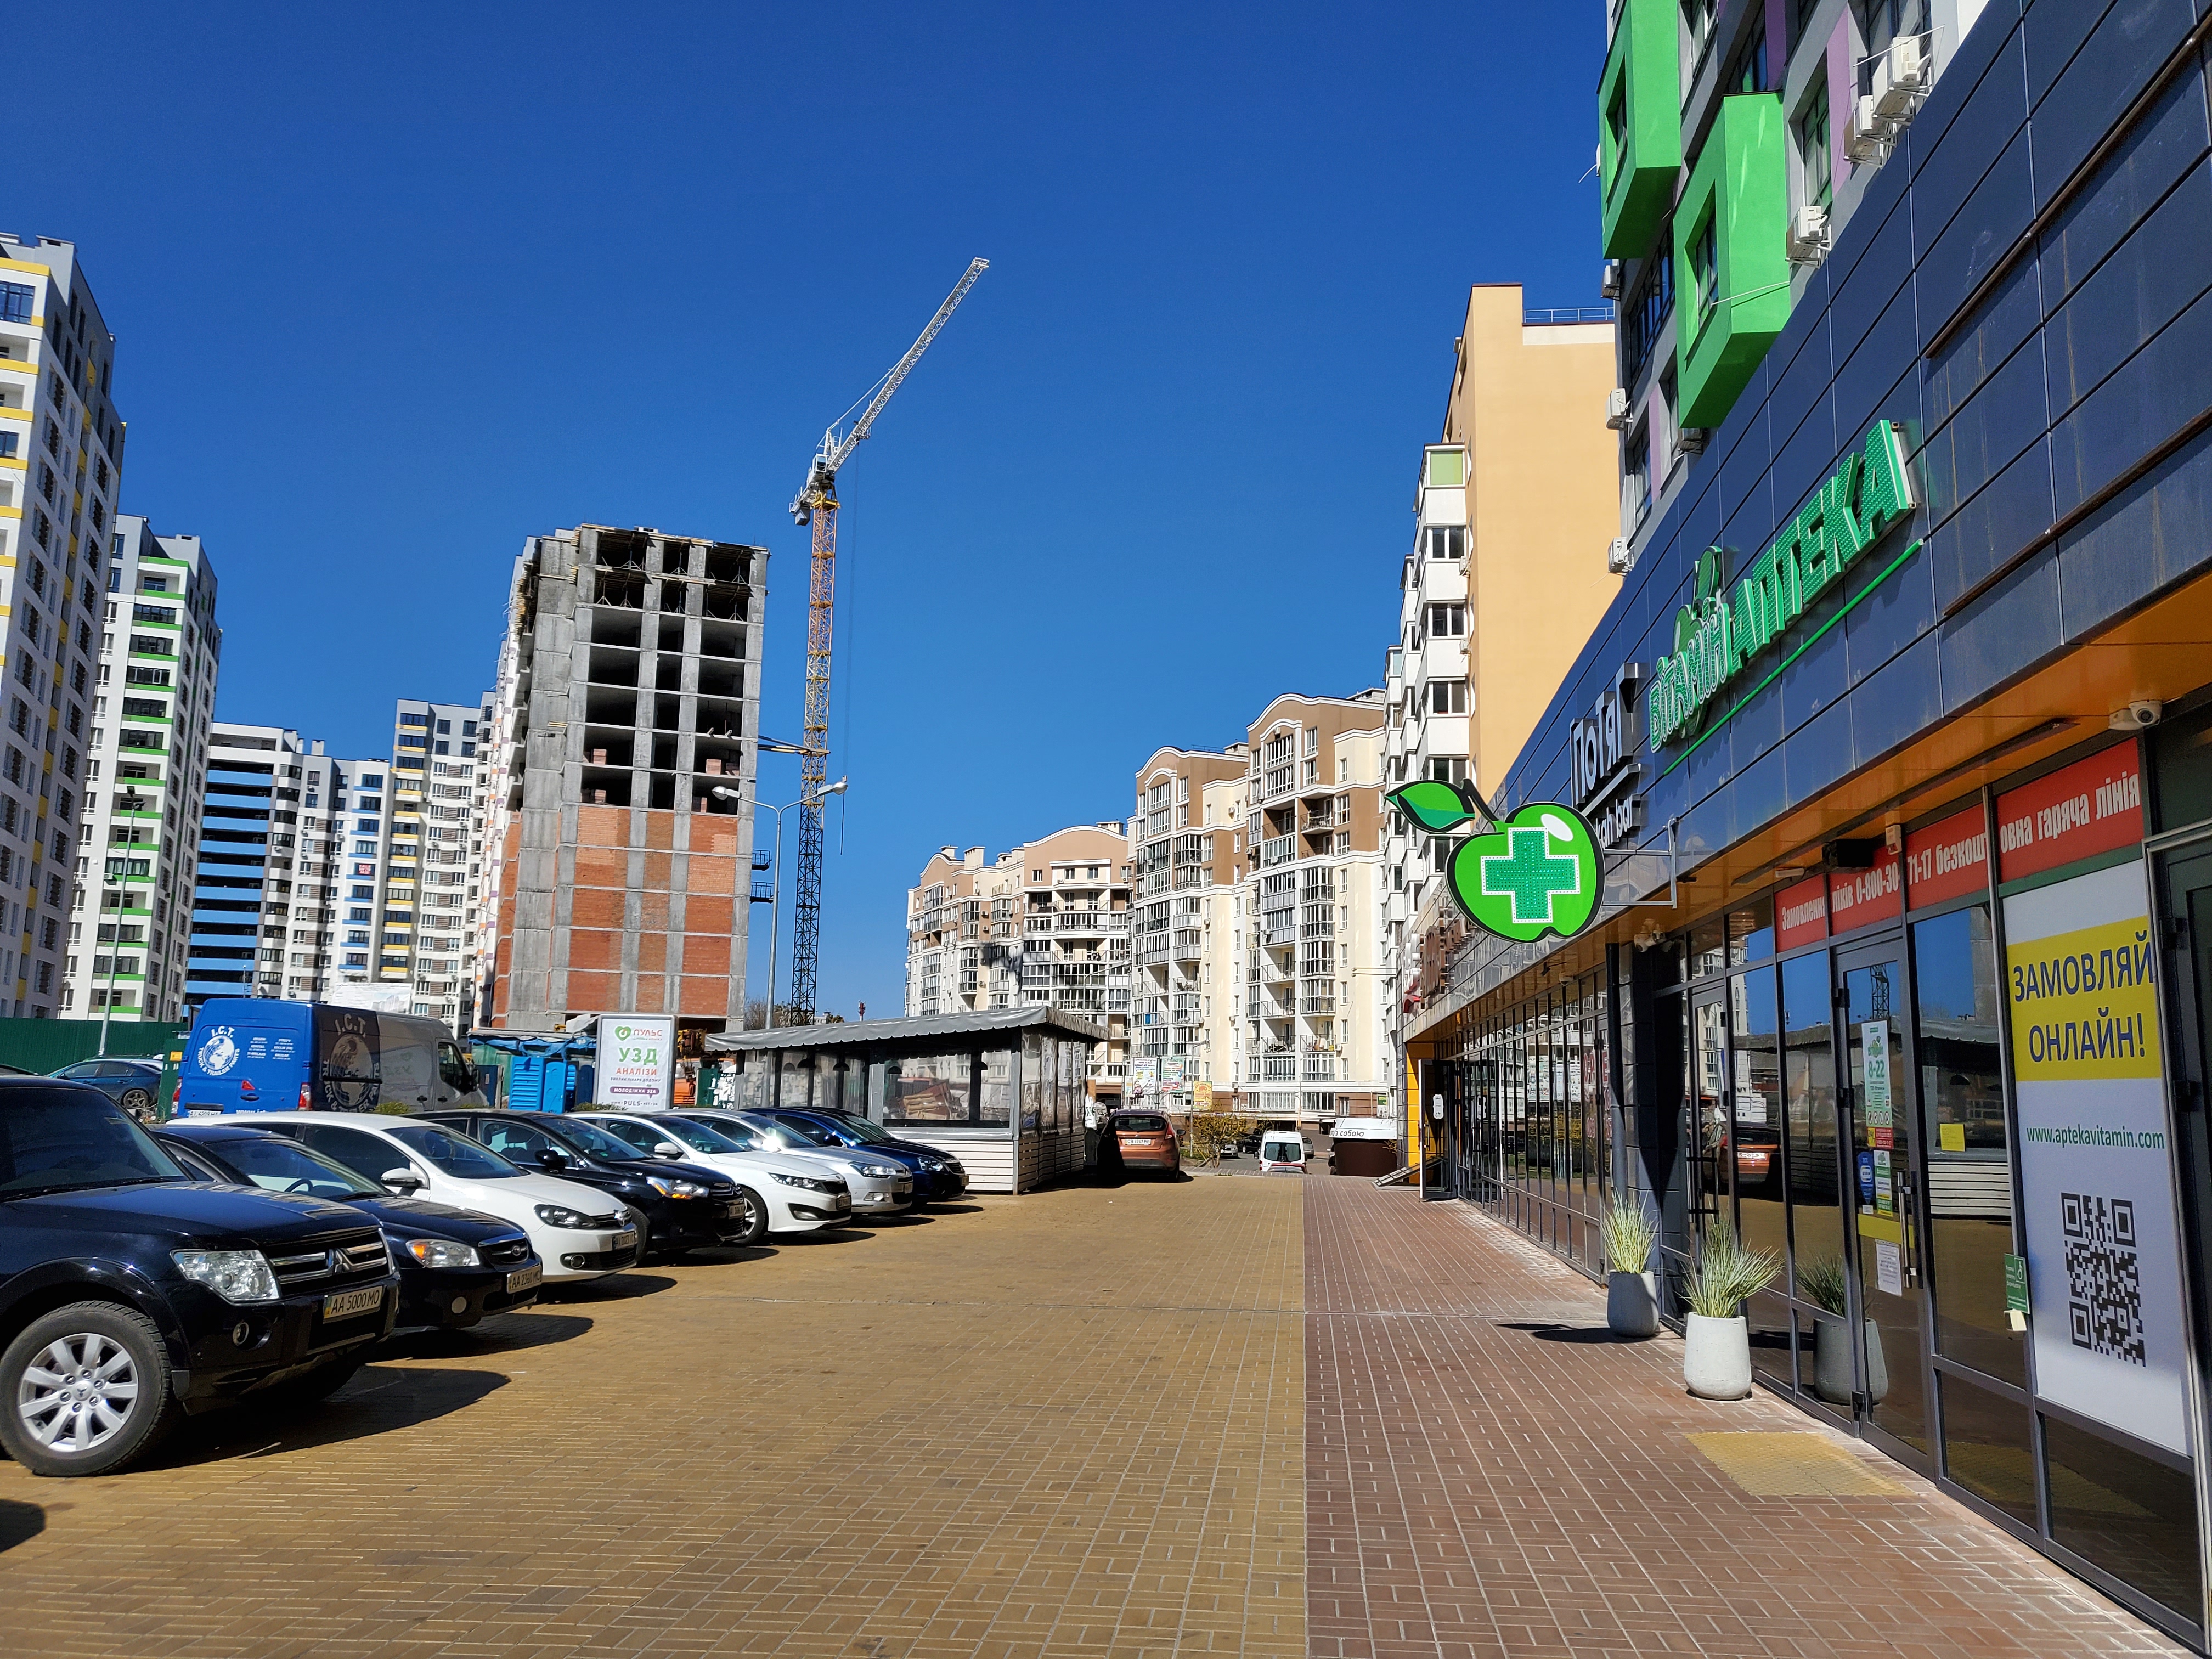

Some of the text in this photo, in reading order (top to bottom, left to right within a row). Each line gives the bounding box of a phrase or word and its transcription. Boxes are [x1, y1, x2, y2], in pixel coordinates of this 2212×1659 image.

[1733, 420, 1909, 675] АПТЕКА
[1616, 795, 1635, 838] bar
[2037, 793, 2090, 840] гаряча
[2096, 771, 2140, 820] лінія
[1832, 882, 1854, 913] ліків
[2013, 930, 2154, 1002] ЗАМОВЛЯЙ
[211, 1025, 235, 1038] I.C.T.
[334, 1013, 366, 1039] I.C.T.
[2029, 1007, 2145, 1063] ОНЛАЙН!
[206, 1065, 230, 1076] TRAILER
[229, 1048, 240, 1068] PARTS
[618, 1047, 658, 1066] УЗД
[2027, 1124, 2165, 1149] www.aptekavitamin.com
[512, 1276, 520, 1289] AA
[331, 1289, 380, 1313] AA 5000 MO
